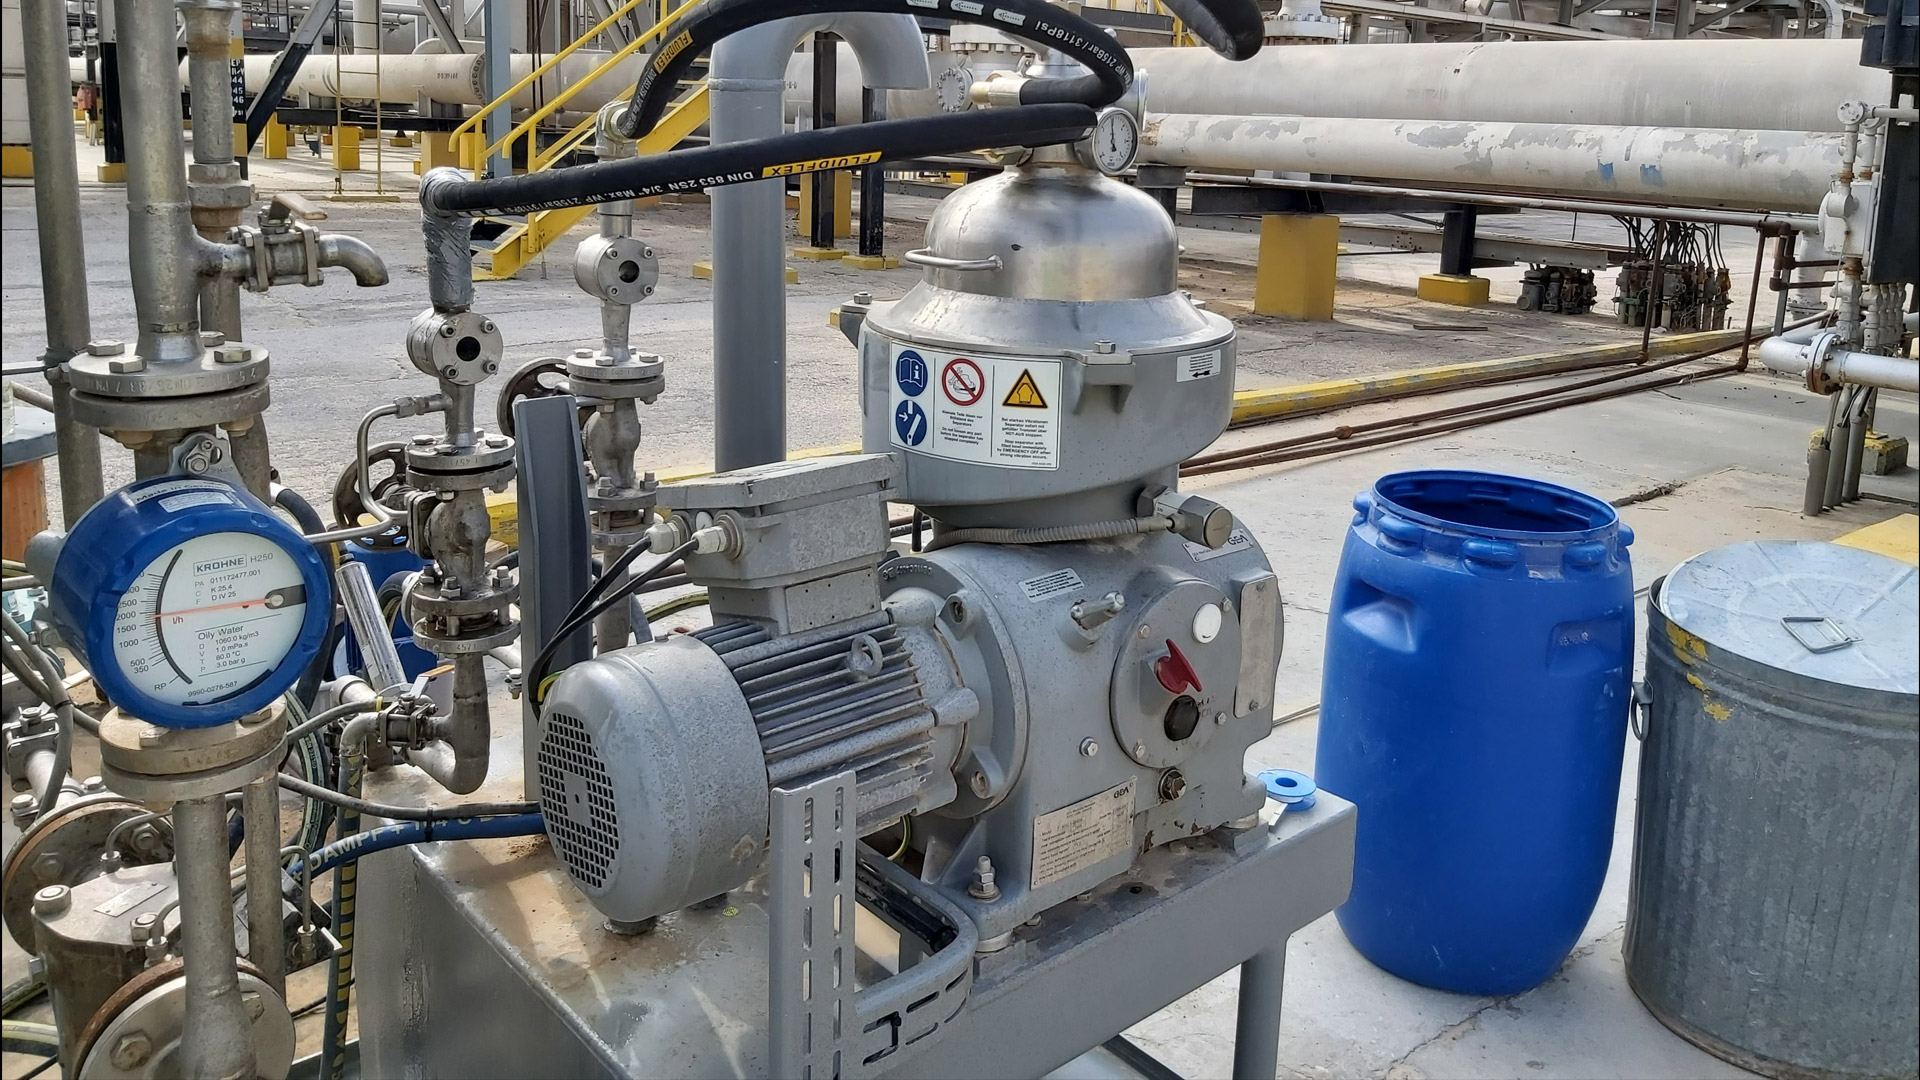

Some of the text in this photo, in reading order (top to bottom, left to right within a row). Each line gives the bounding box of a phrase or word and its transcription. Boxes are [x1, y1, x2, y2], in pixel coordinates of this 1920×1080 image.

[656, 34, 688, 70] FLUIDFLEX
[233, 96, 244, 104] 46
[771, 154, 873, 176] FLUIDFLEX
[699, 176, 725, 186] 853
[727, 171, 754, 182] DIN
[638, 185, 664, 196] 3/4"
[668, 180, 698, 191] 2SN
[585, 193, 604, 202] WP
[1228, 534, 1249, 546] GEA
[196, 552, 274, 573] KROHNE H250
[194, 569, 261, 588] PA 011172477.001
[218, 584, 233, 592] 25.4
[116, 611, 136, 621] 2000
[172, 616, 184, 624] l/h
[116, 624, 137, 634] 1500
[198, 626, 244, 640] Oily Water
[239, 631, 259, 641] kg/m3
[119, 639, 139, 648] 1000
[227, 642, 249, 651] mPa.s
[130, 658, 146, 668] 500
[134, 665, 149, 674] 350
[154, 682, 167, 691] RP
[1113, 786, 1129, 799] GEA
[309, 826, 384, 872] DAMPF
